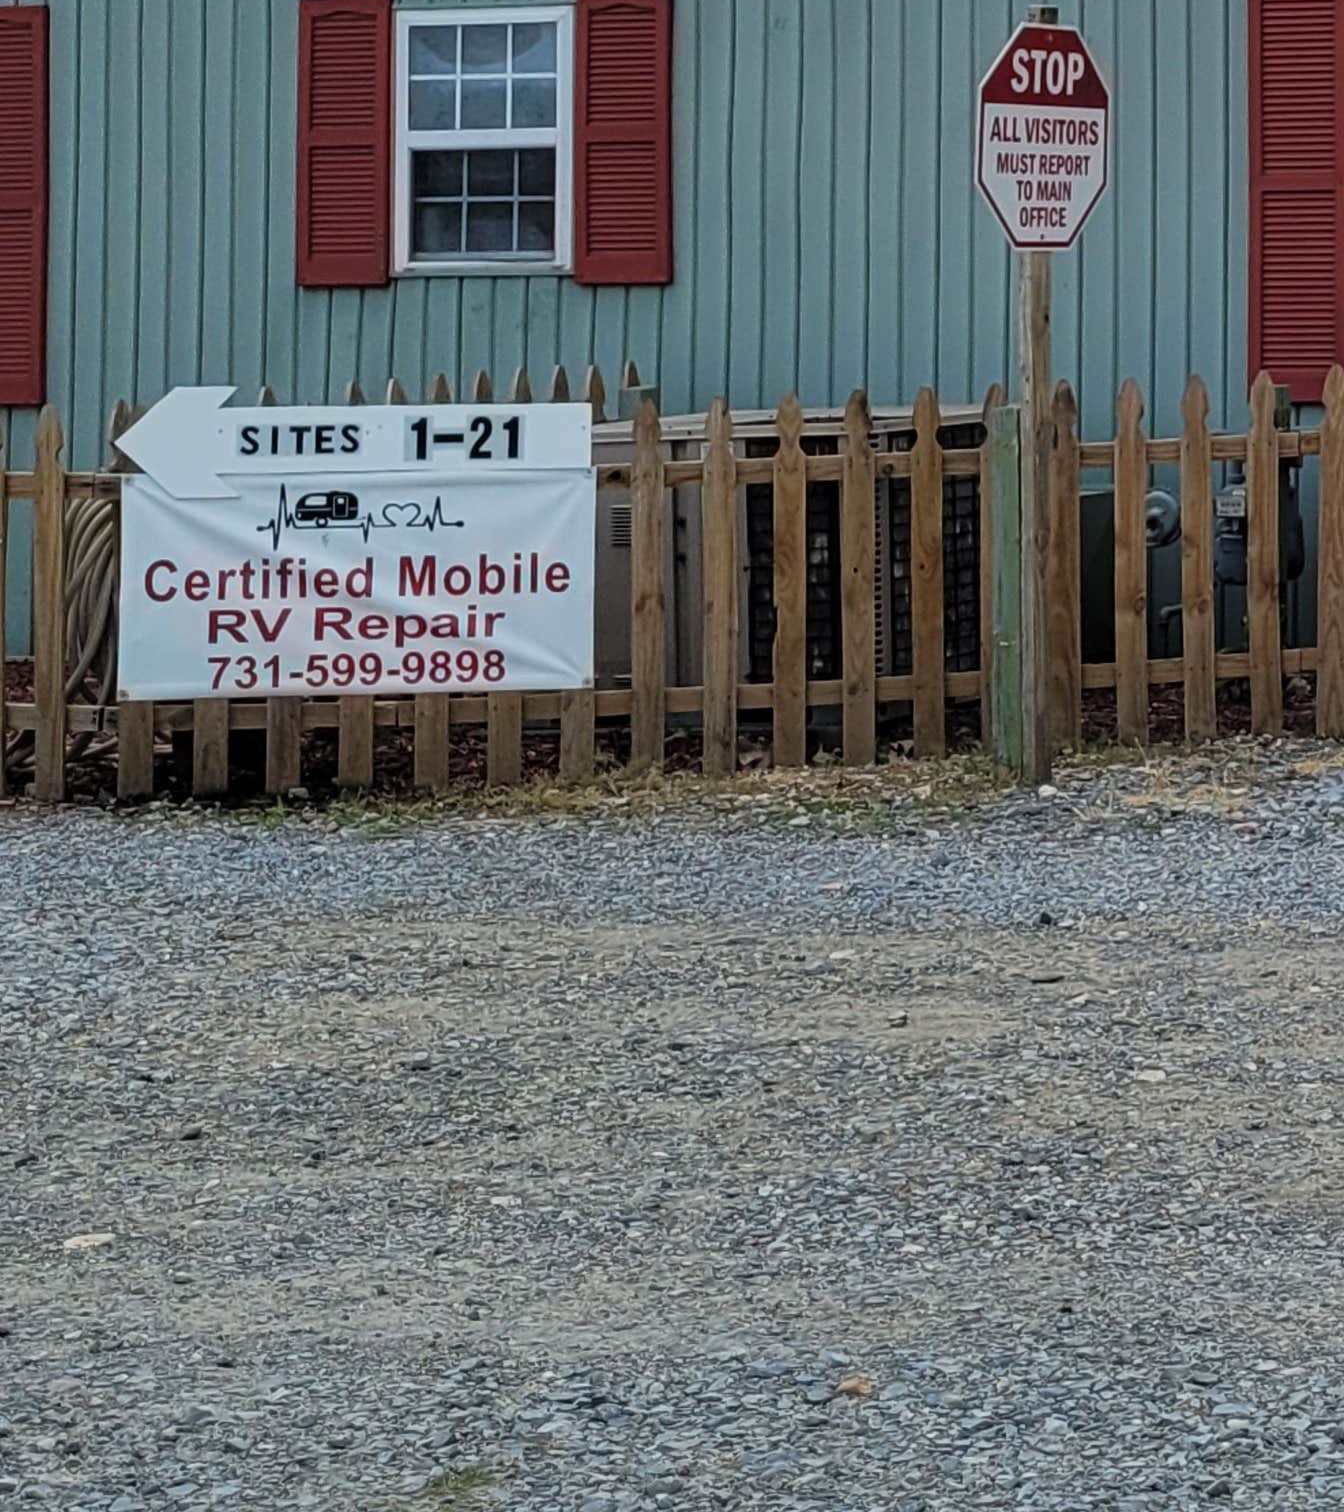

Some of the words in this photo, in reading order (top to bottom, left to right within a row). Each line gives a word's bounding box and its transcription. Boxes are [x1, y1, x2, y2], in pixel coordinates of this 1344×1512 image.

[1010, 48, 1085, 96] STOP
[990, 116, 1021, 143] ALL
[1024, 117, 1099, 146] VISITORS
[996, 152, 1037, 175] MUST
[1040, 154, 1091, 177] REPORT
[1016, 179, 1033, 201] TO
[1036, 180, 1072, 202] MAIN
[1019, 206, 1067, 228] OFFICE
[239, 423, 361, 457] SITES
[409, 415, 521, 460] 1-21
[144, 555, 374, 602] Certified
[399, 552, 571, 597] Mobile
[207, 607, 292, 645] RV
[313, 603, 508, 648] Repair
[207, 649, 508, 691] 731-599-9898
